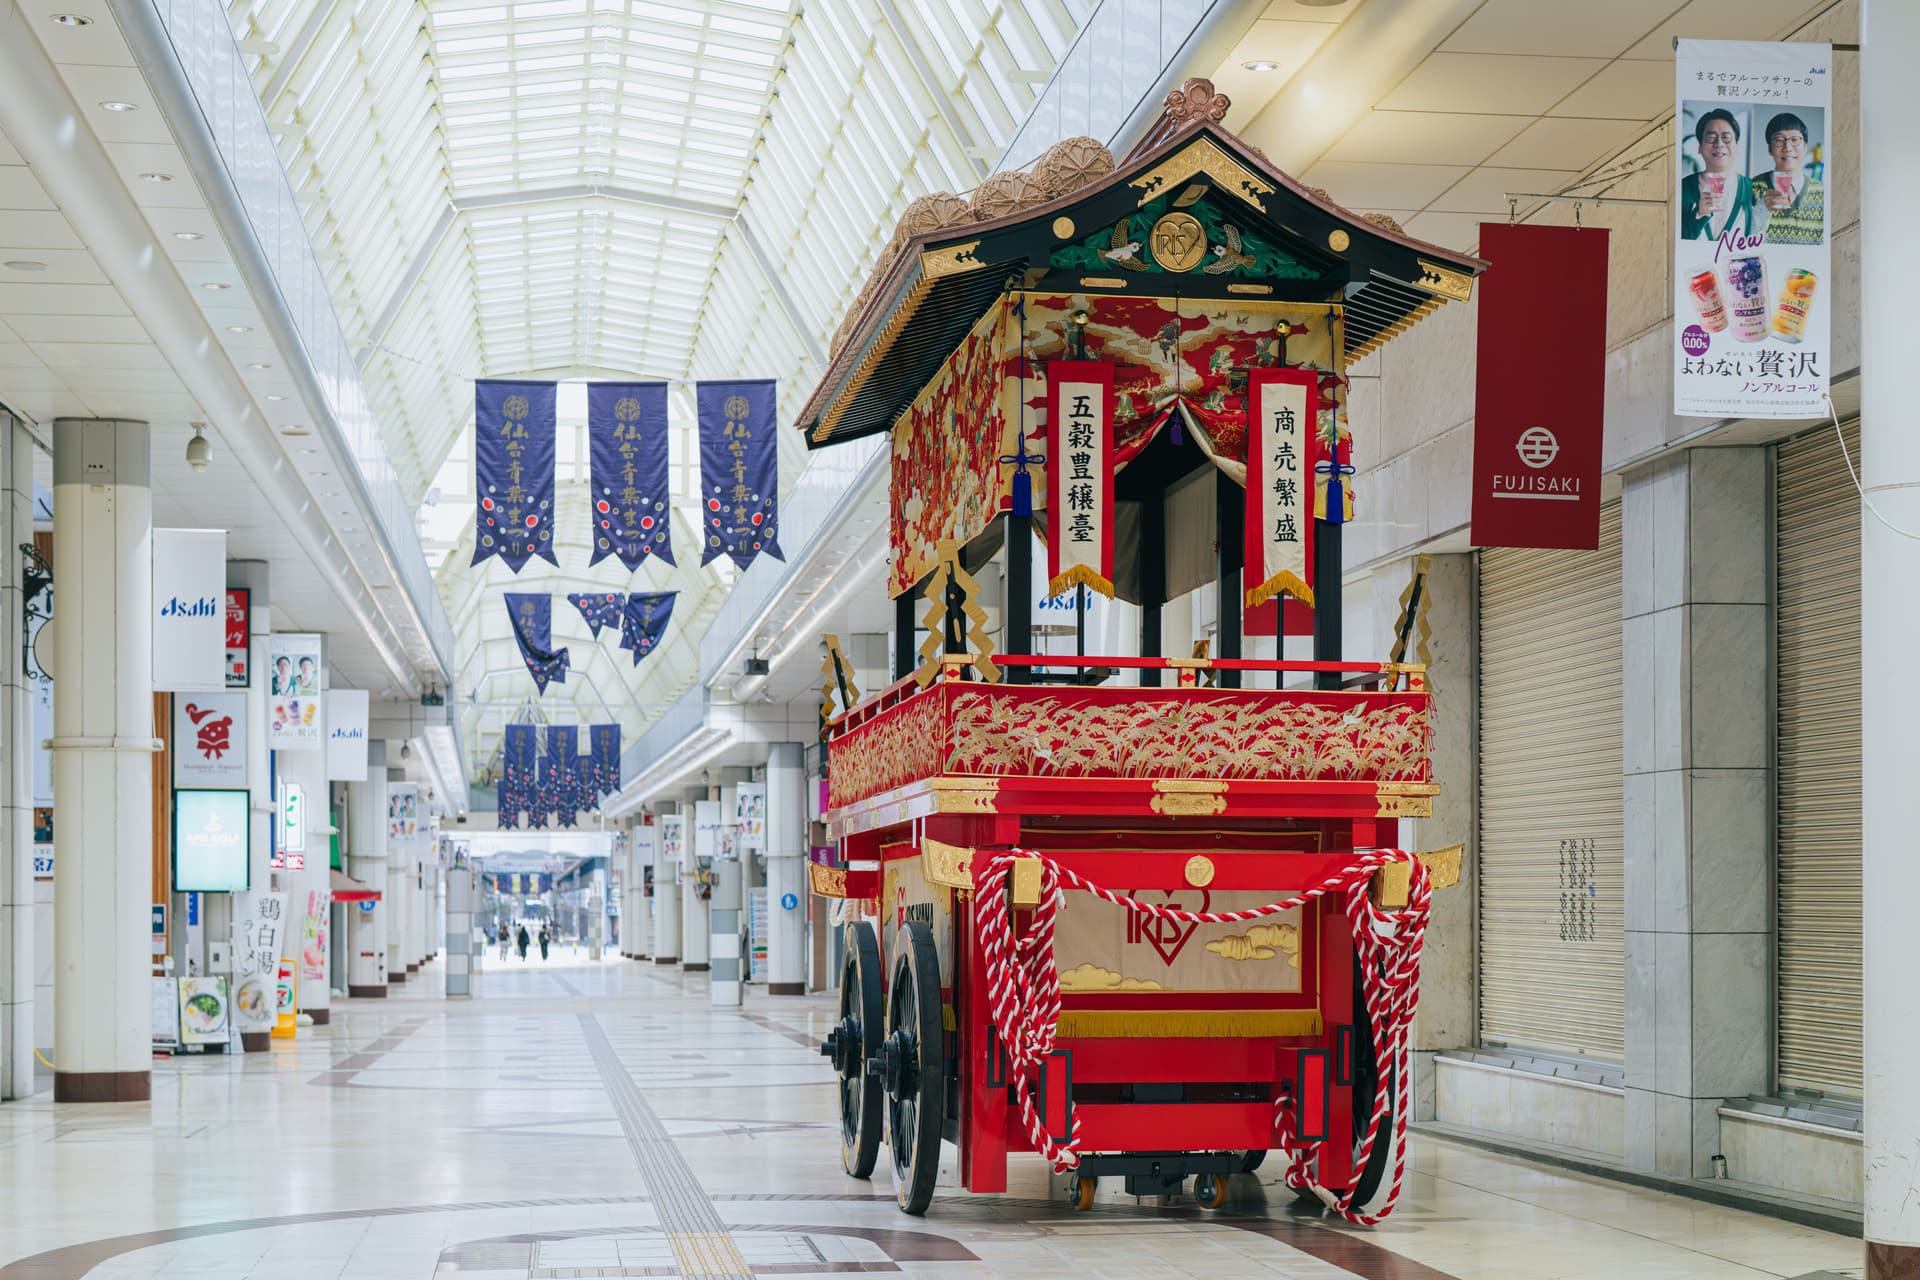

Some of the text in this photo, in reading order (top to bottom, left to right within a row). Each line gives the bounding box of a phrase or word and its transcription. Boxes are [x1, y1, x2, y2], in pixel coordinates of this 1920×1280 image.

[1156, 233, 1186, 256] IRIS
[1714, 228, 1763, 264] New
[1683, 337, 1708, 349] 0.00%
[1681, 350, 1821, 378] よわない贅沢
[1740, 381, 1820, 393] ノンアルコール
[501, 420, 529, 556] 仙台青葉まつり
[613, 422, 642, 558] 仙台青葉まつり
[723, 420, 752, 555] 仙台青葉まつり
[1272, 406, 1299, 543] 商売繁盛
[1493, 475, 1580, 492] FUJISAKI
[161, 596, 217, 617] Asahi
[332, 728, 363, 738] Asahi
[242, 919, 255, 977] ラーメン
[257, 897, 280, 974] 鶏白湯
